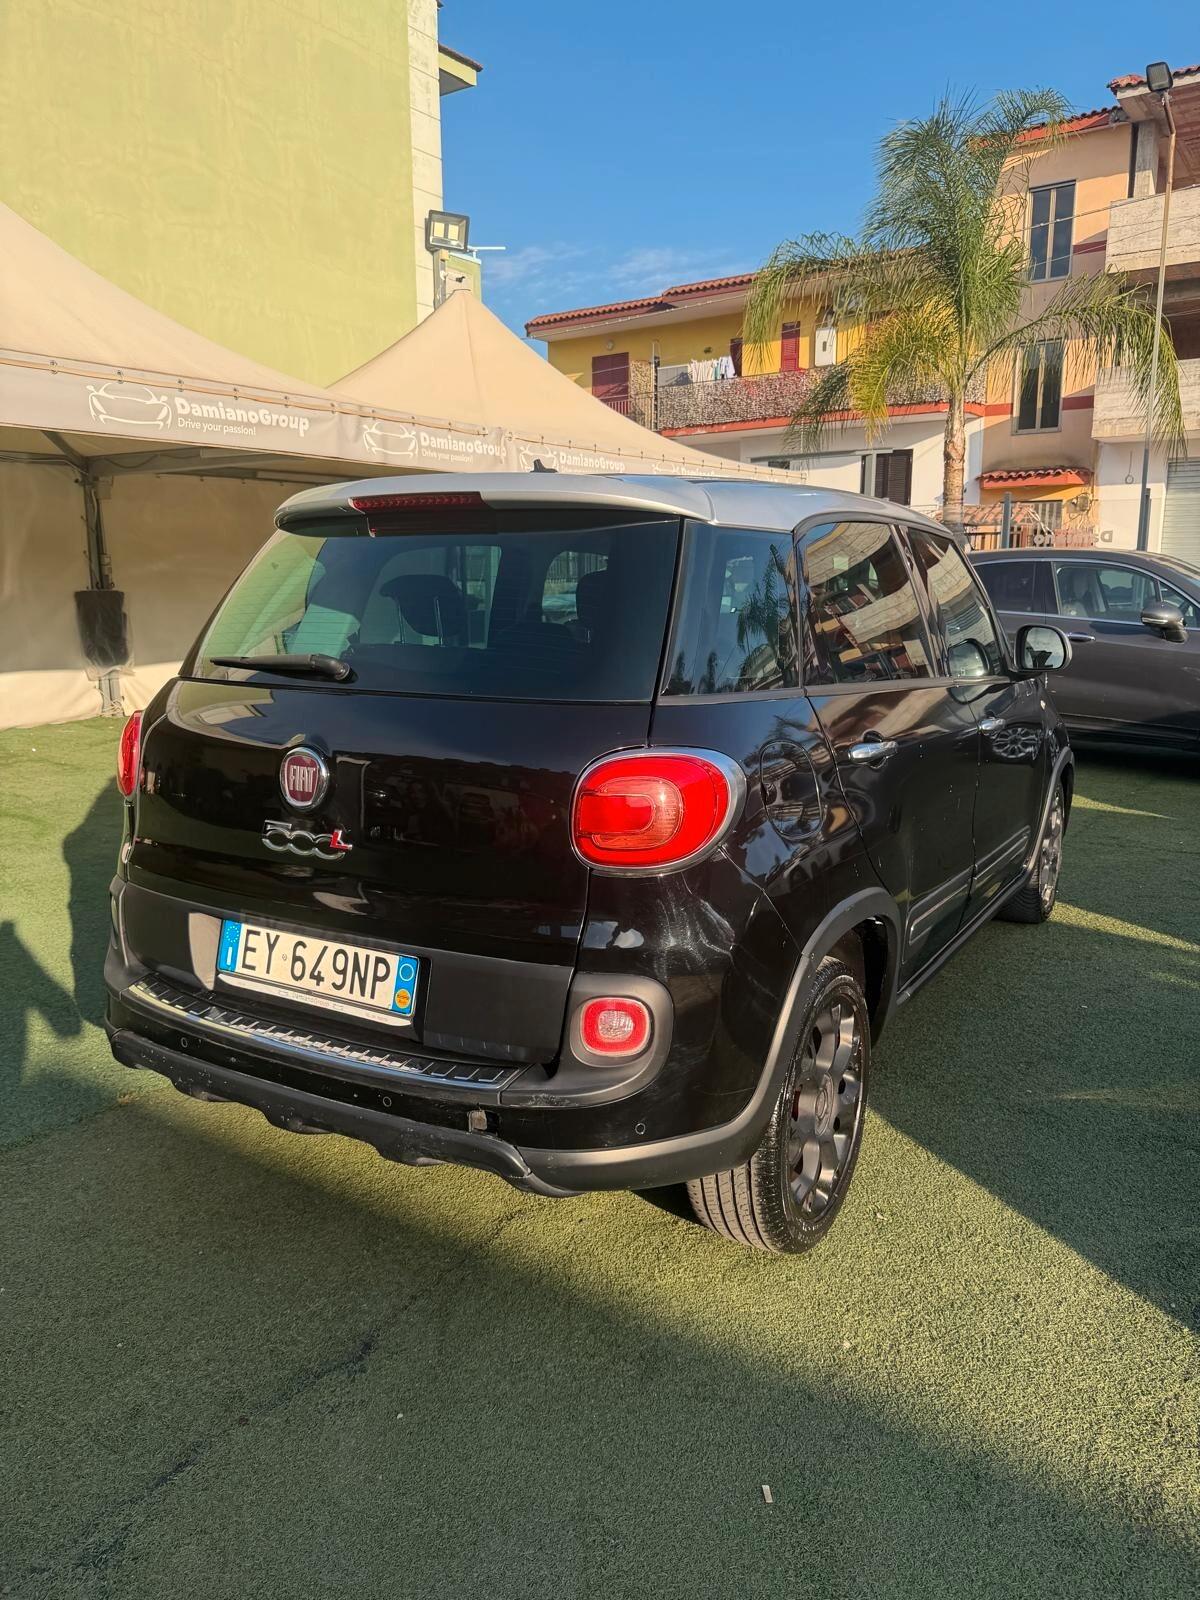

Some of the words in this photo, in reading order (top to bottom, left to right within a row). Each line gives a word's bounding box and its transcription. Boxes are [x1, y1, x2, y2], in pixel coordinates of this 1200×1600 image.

[174, 396, 310, 437] DamianoGroup
[177, 417, 201, 430] Drive
[202, 422, 222, 433] your
[223, 425, 257, 436] passion!
[419, 431, 507, 465] DamianoGroup
[559, 452, 626, 473] DamianoGroup
[288, 764, 317, 793] FIAT
[261, 819, 353, 860] 500L
